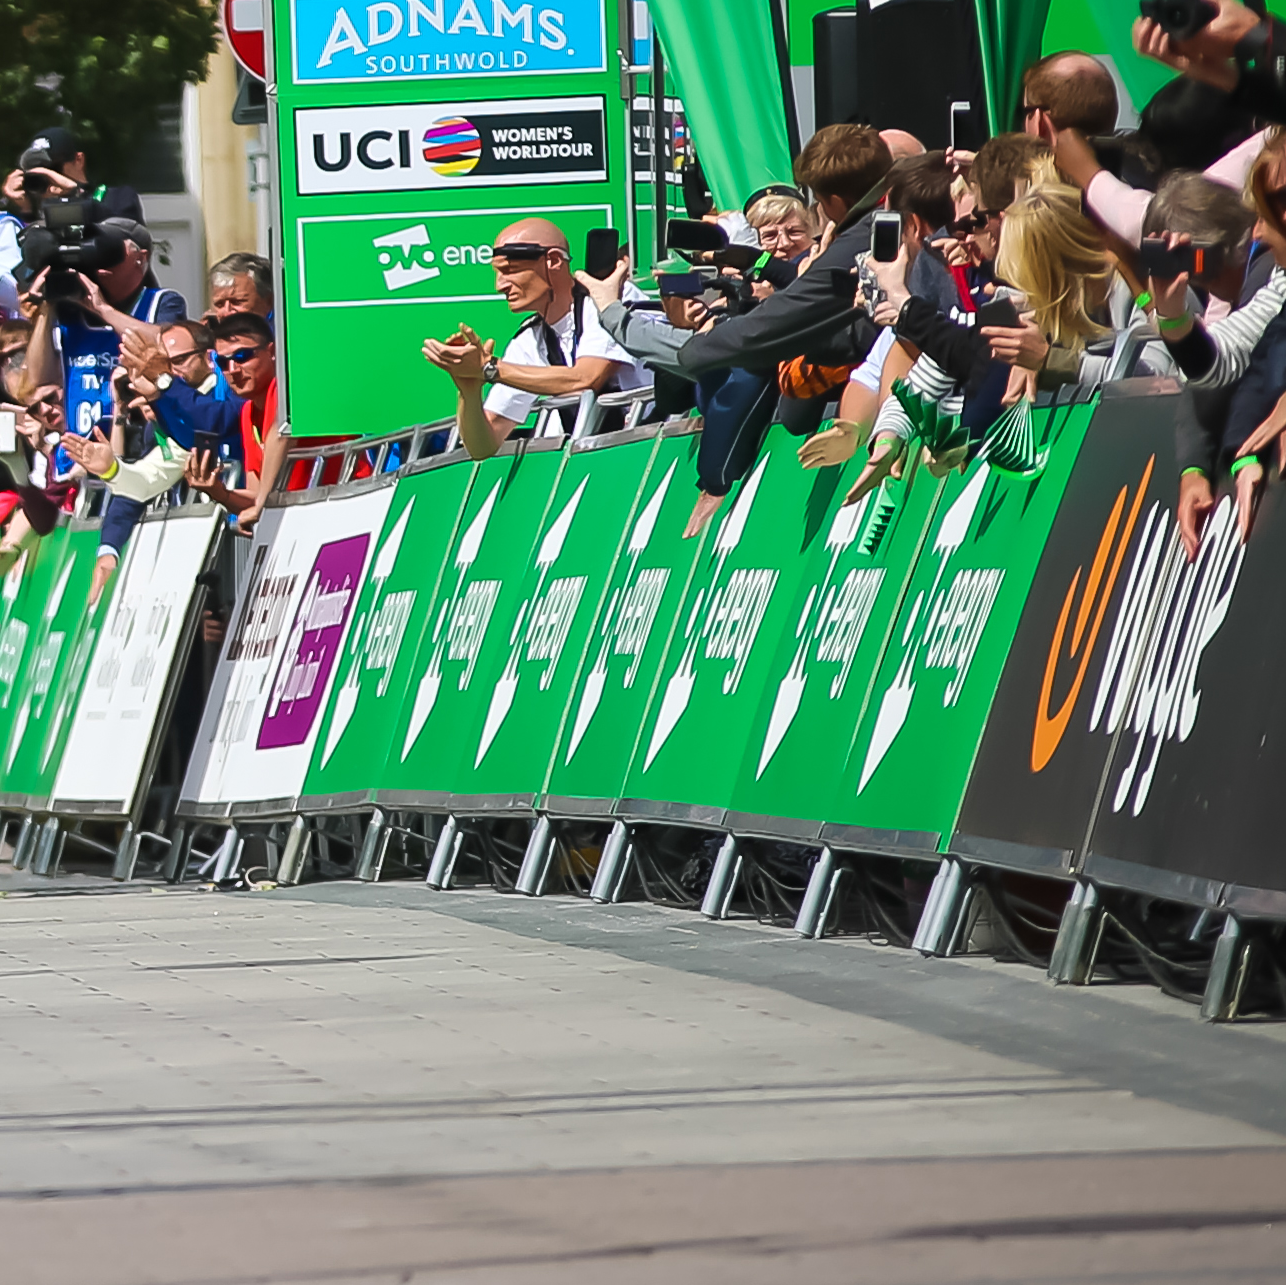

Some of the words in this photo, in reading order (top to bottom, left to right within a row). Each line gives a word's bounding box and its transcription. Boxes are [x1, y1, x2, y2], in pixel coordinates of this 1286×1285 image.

[365, 50, 528, 75] SOUTHWOLD
[492, 126, 574, 143] WOMEN'S
[312, 128, 412, 173] UCI
[492, 142, 594, 161] WORLDTOUR
[925, 567, 1006, 709] energy
